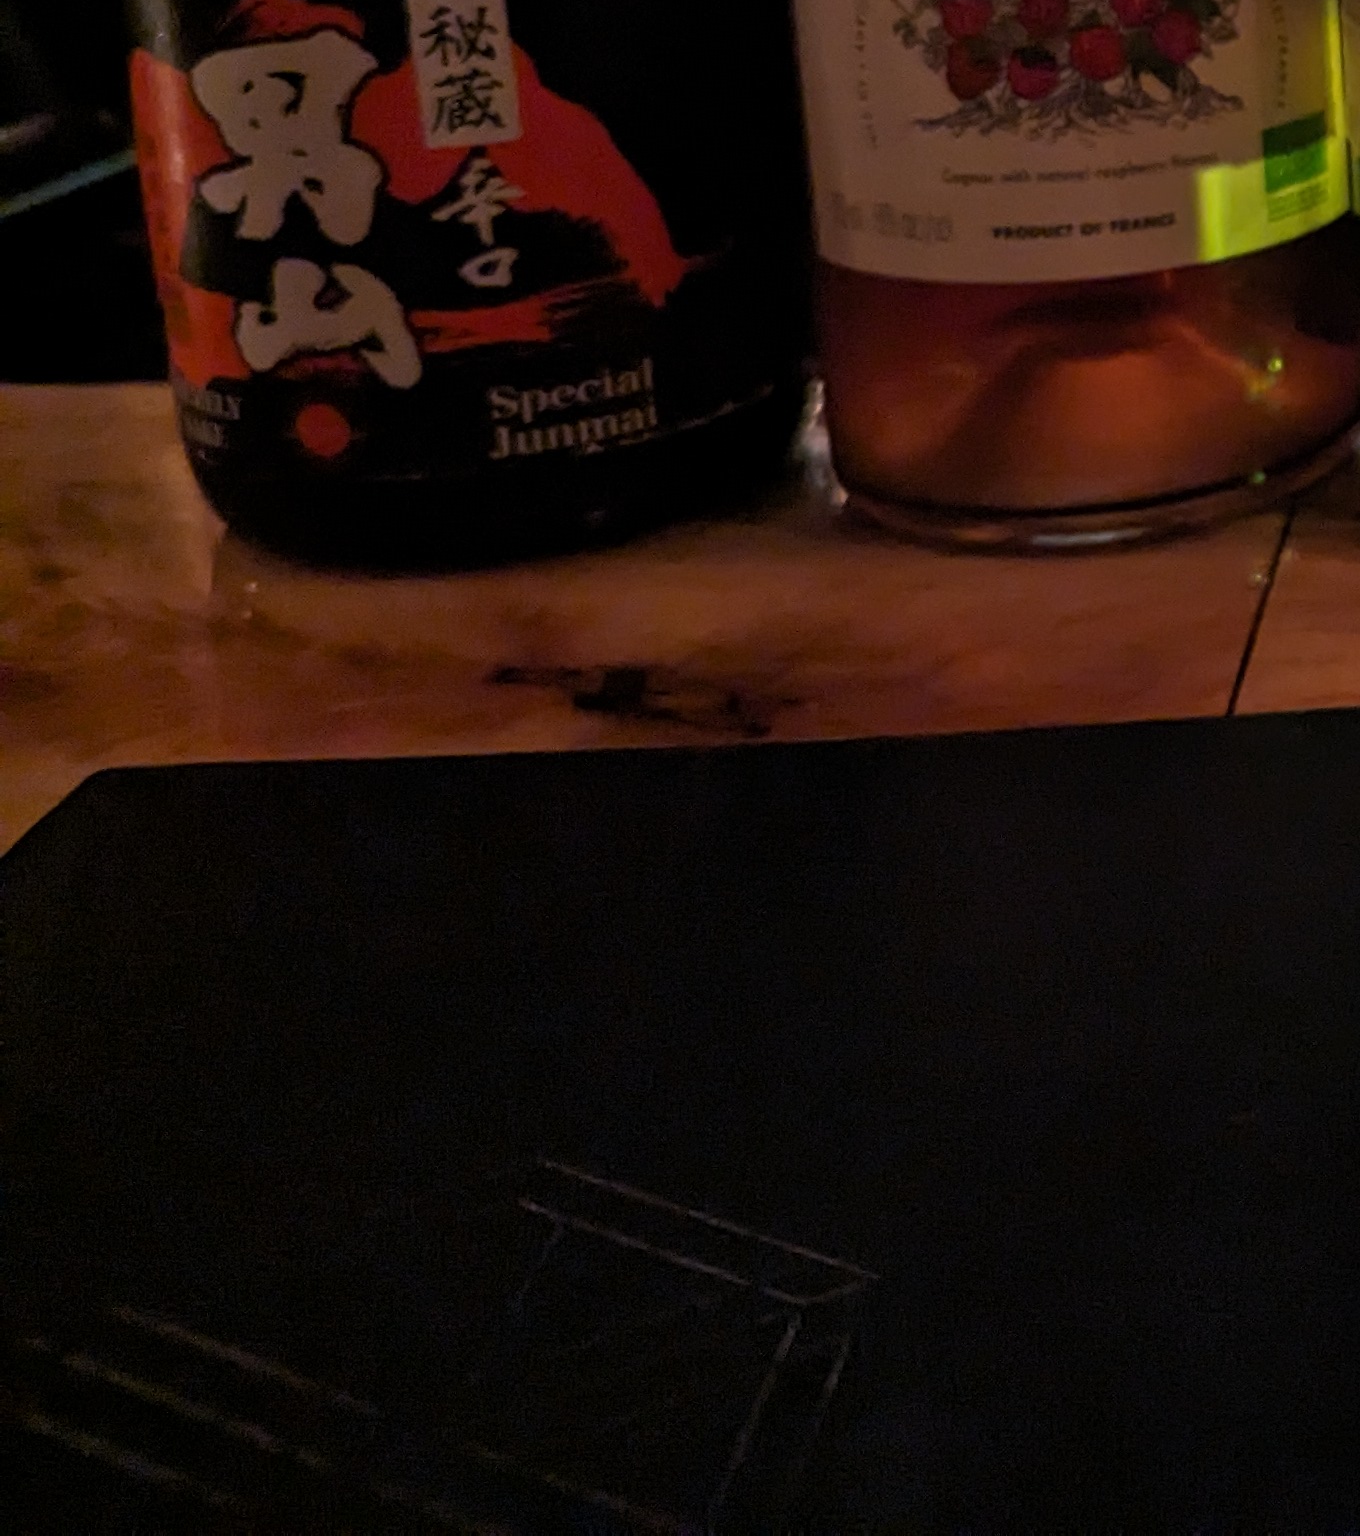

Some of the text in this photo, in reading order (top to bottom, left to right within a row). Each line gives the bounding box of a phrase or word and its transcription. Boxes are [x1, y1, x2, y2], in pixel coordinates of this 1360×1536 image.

[420, 4, 507, 133] 秘蔵
[431, 147, 527, 288] 辛口
[993, 211, 1176, 240] PRODUCT OF FRANCE
[485, 356, 655, 424] Special
[487, 402, 658, 461] Junmai
